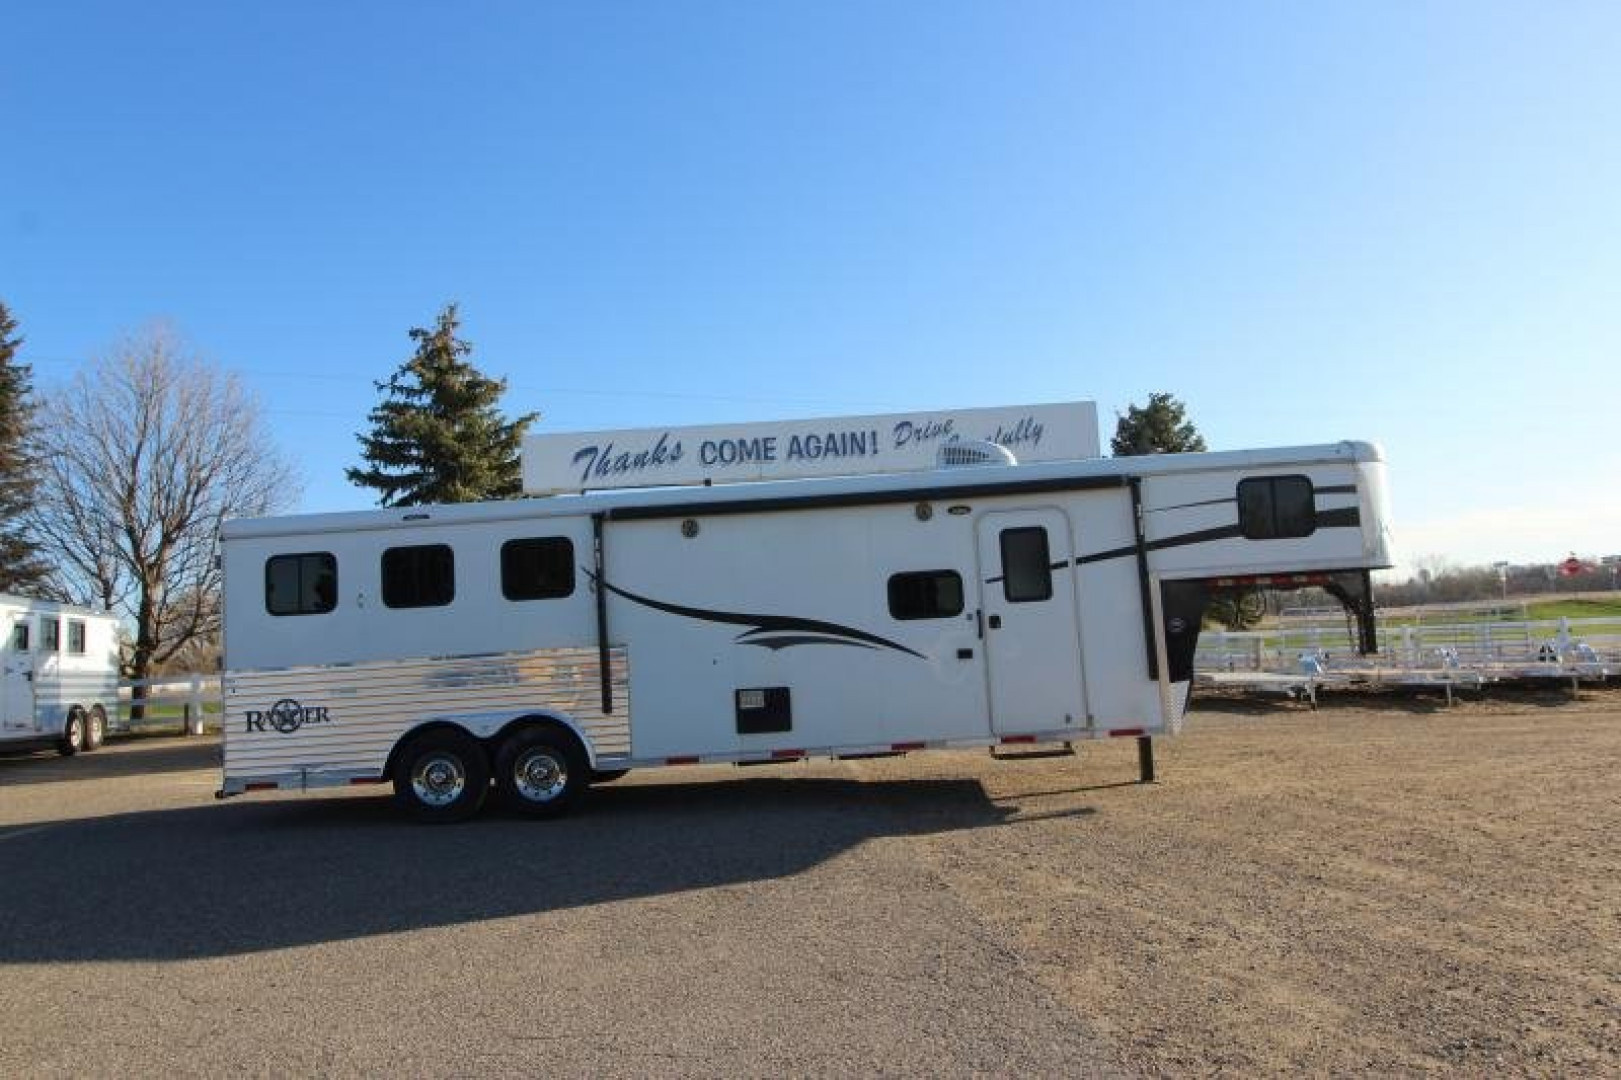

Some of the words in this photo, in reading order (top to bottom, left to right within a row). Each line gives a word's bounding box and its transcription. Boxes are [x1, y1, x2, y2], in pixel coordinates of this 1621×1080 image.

[894, 418, 954, 448] Drive
[572, 432, 684, 482] Thanks
[700, 437, 777, 465] COME
[788, 430, 878, 459] AGAIN!
